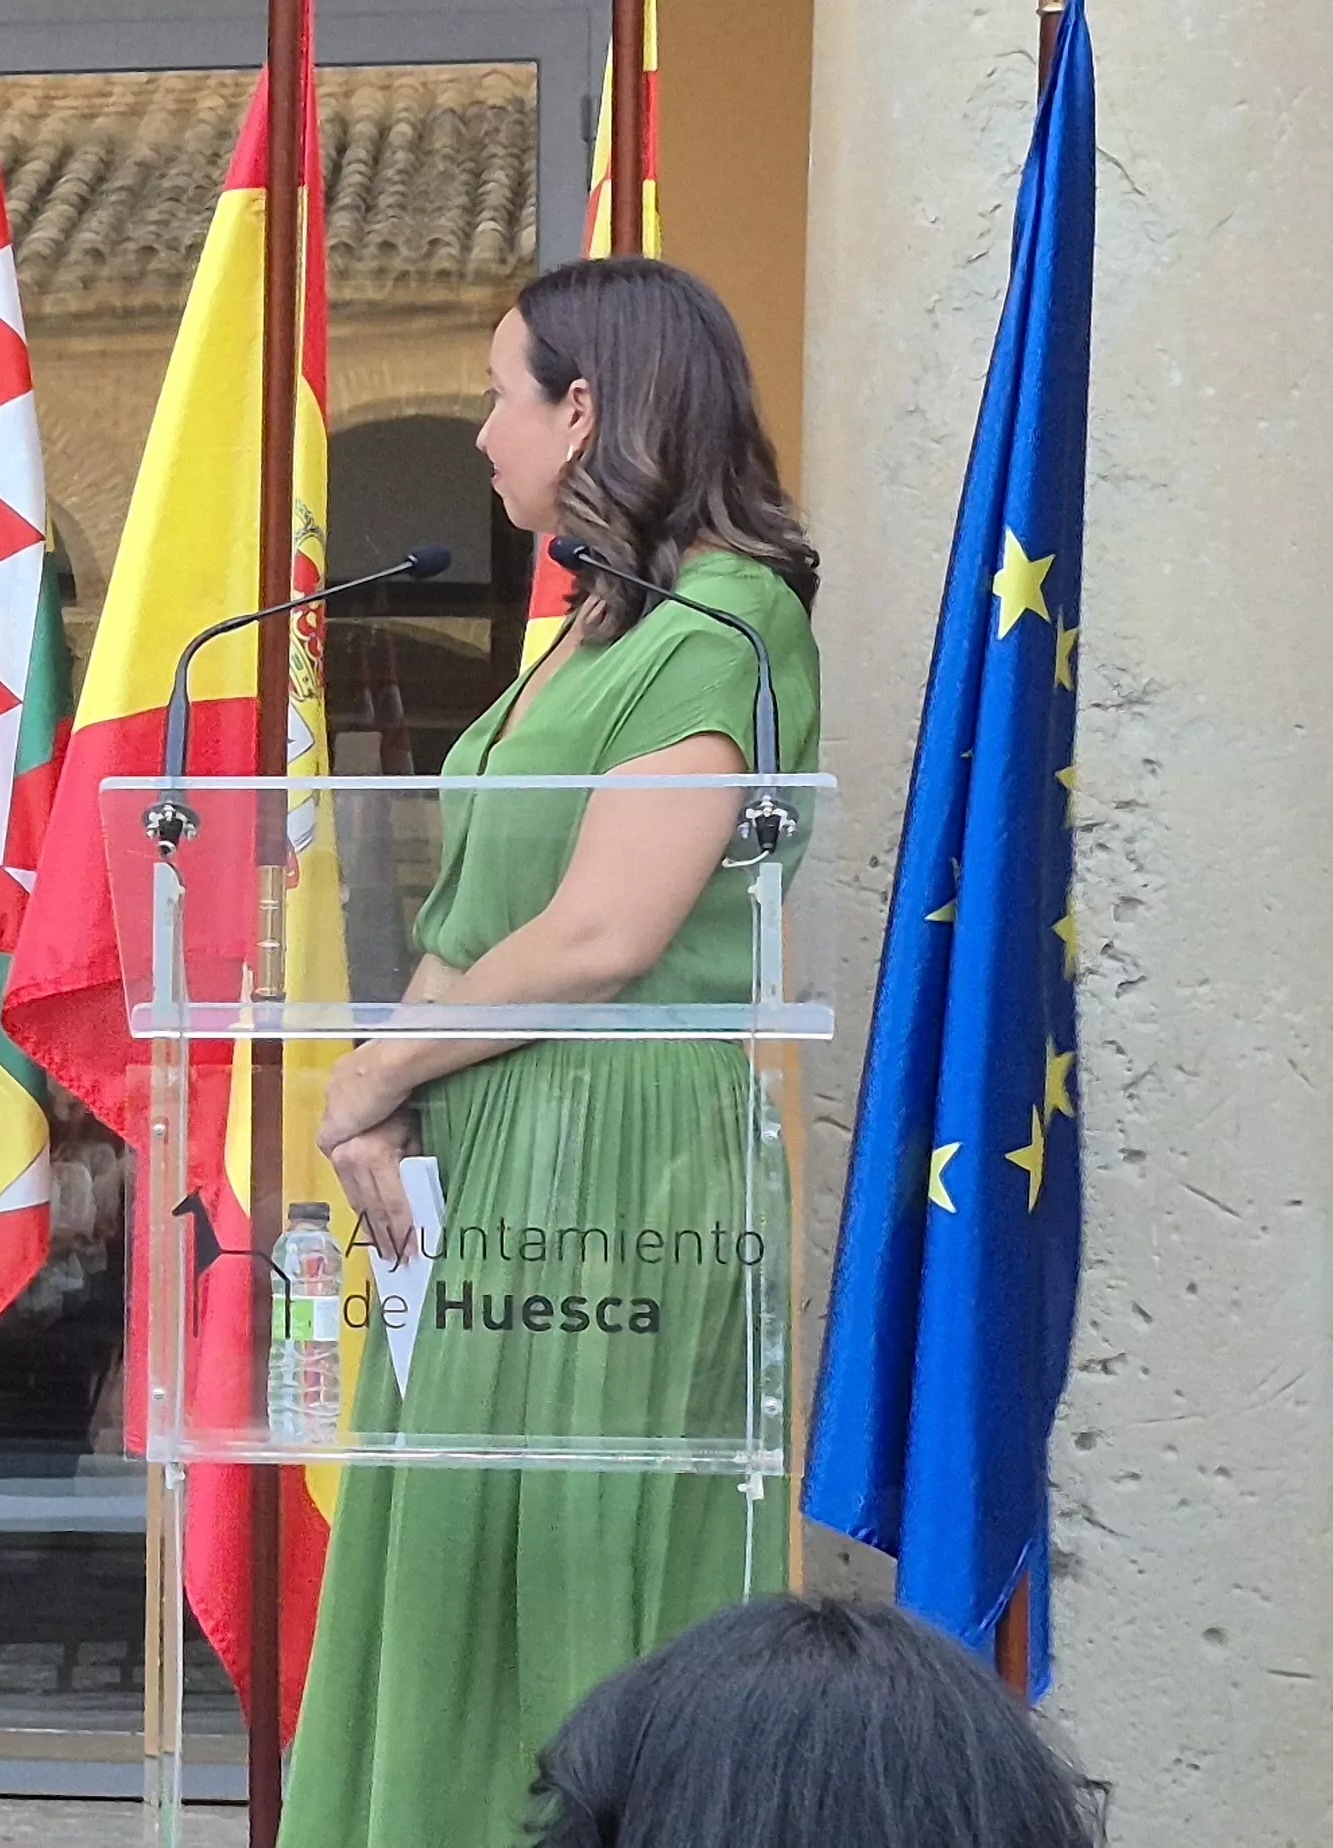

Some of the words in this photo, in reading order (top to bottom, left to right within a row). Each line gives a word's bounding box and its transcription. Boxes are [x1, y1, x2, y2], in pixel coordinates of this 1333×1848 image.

[345, 1209, 765, 1272] Ayuntamiento
[343, 1279, 409, 1329] de
[434, 1279, 662, 1334] Huesca
